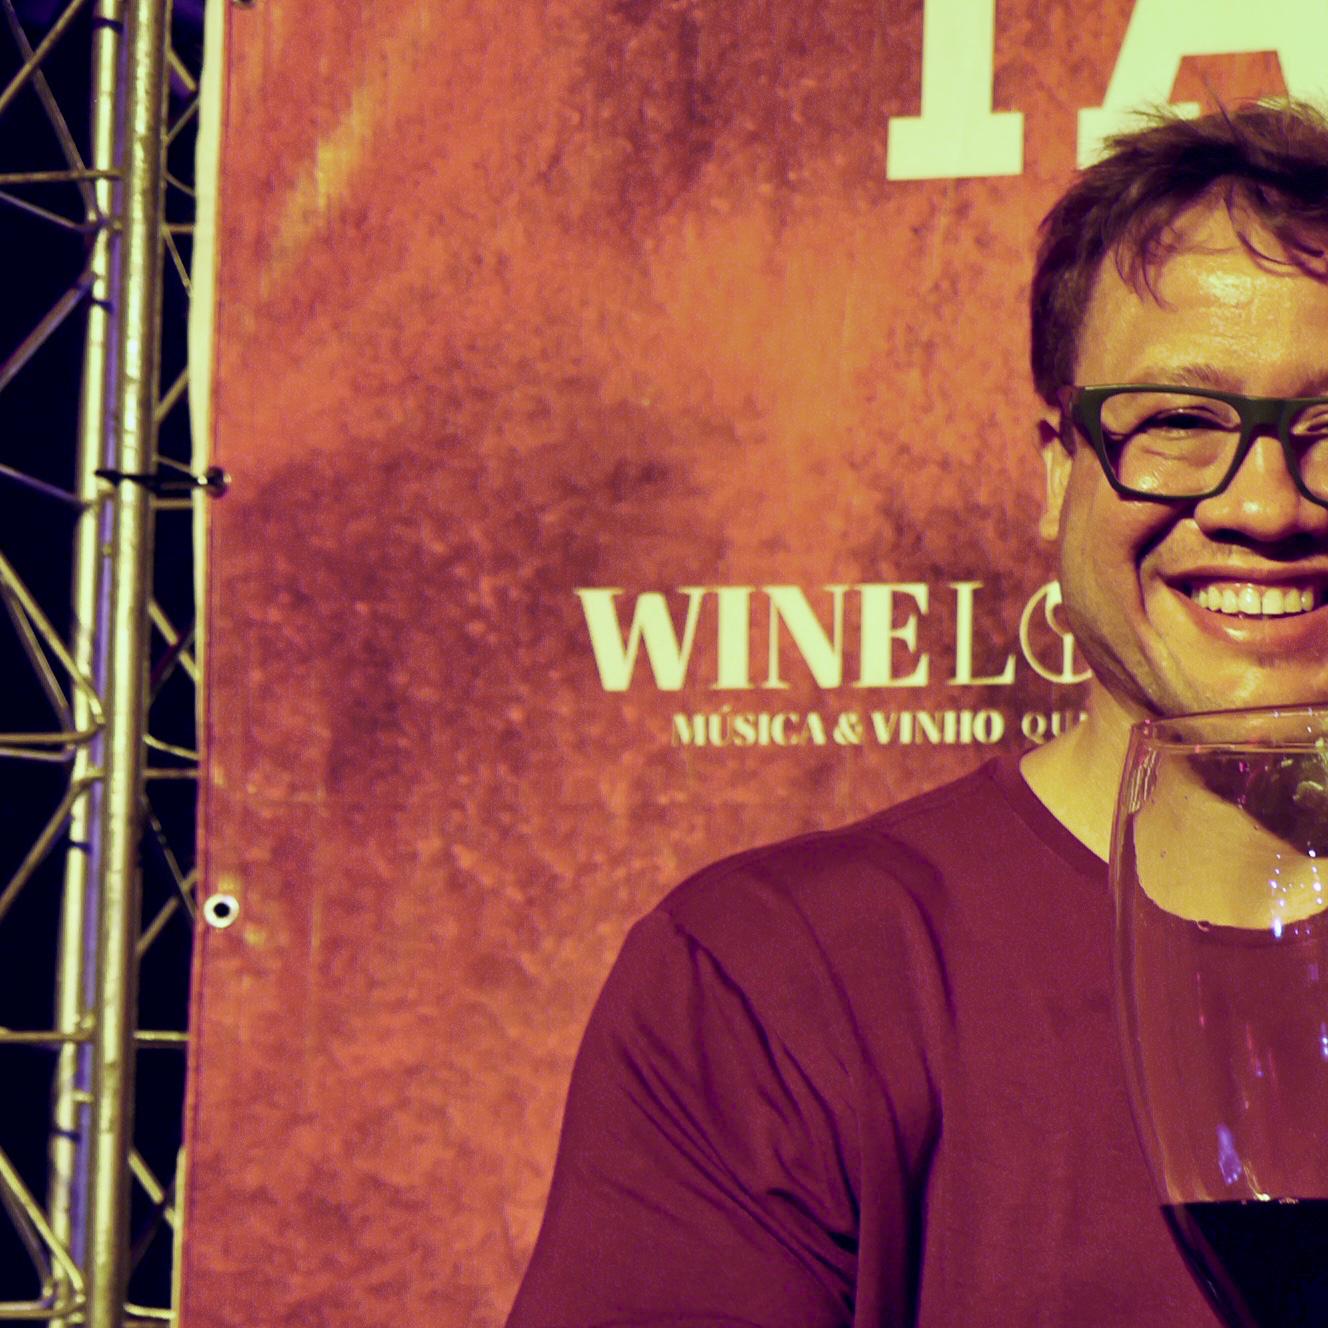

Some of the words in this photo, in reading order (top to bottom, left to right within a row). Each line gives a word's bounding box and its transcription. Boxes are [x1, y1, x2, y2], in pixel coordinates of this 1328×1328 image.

[671, 704, 826, 747] MÚSICA
[832, 710, 863, 746] &
[870, 709, 1005, 745] VINHO
